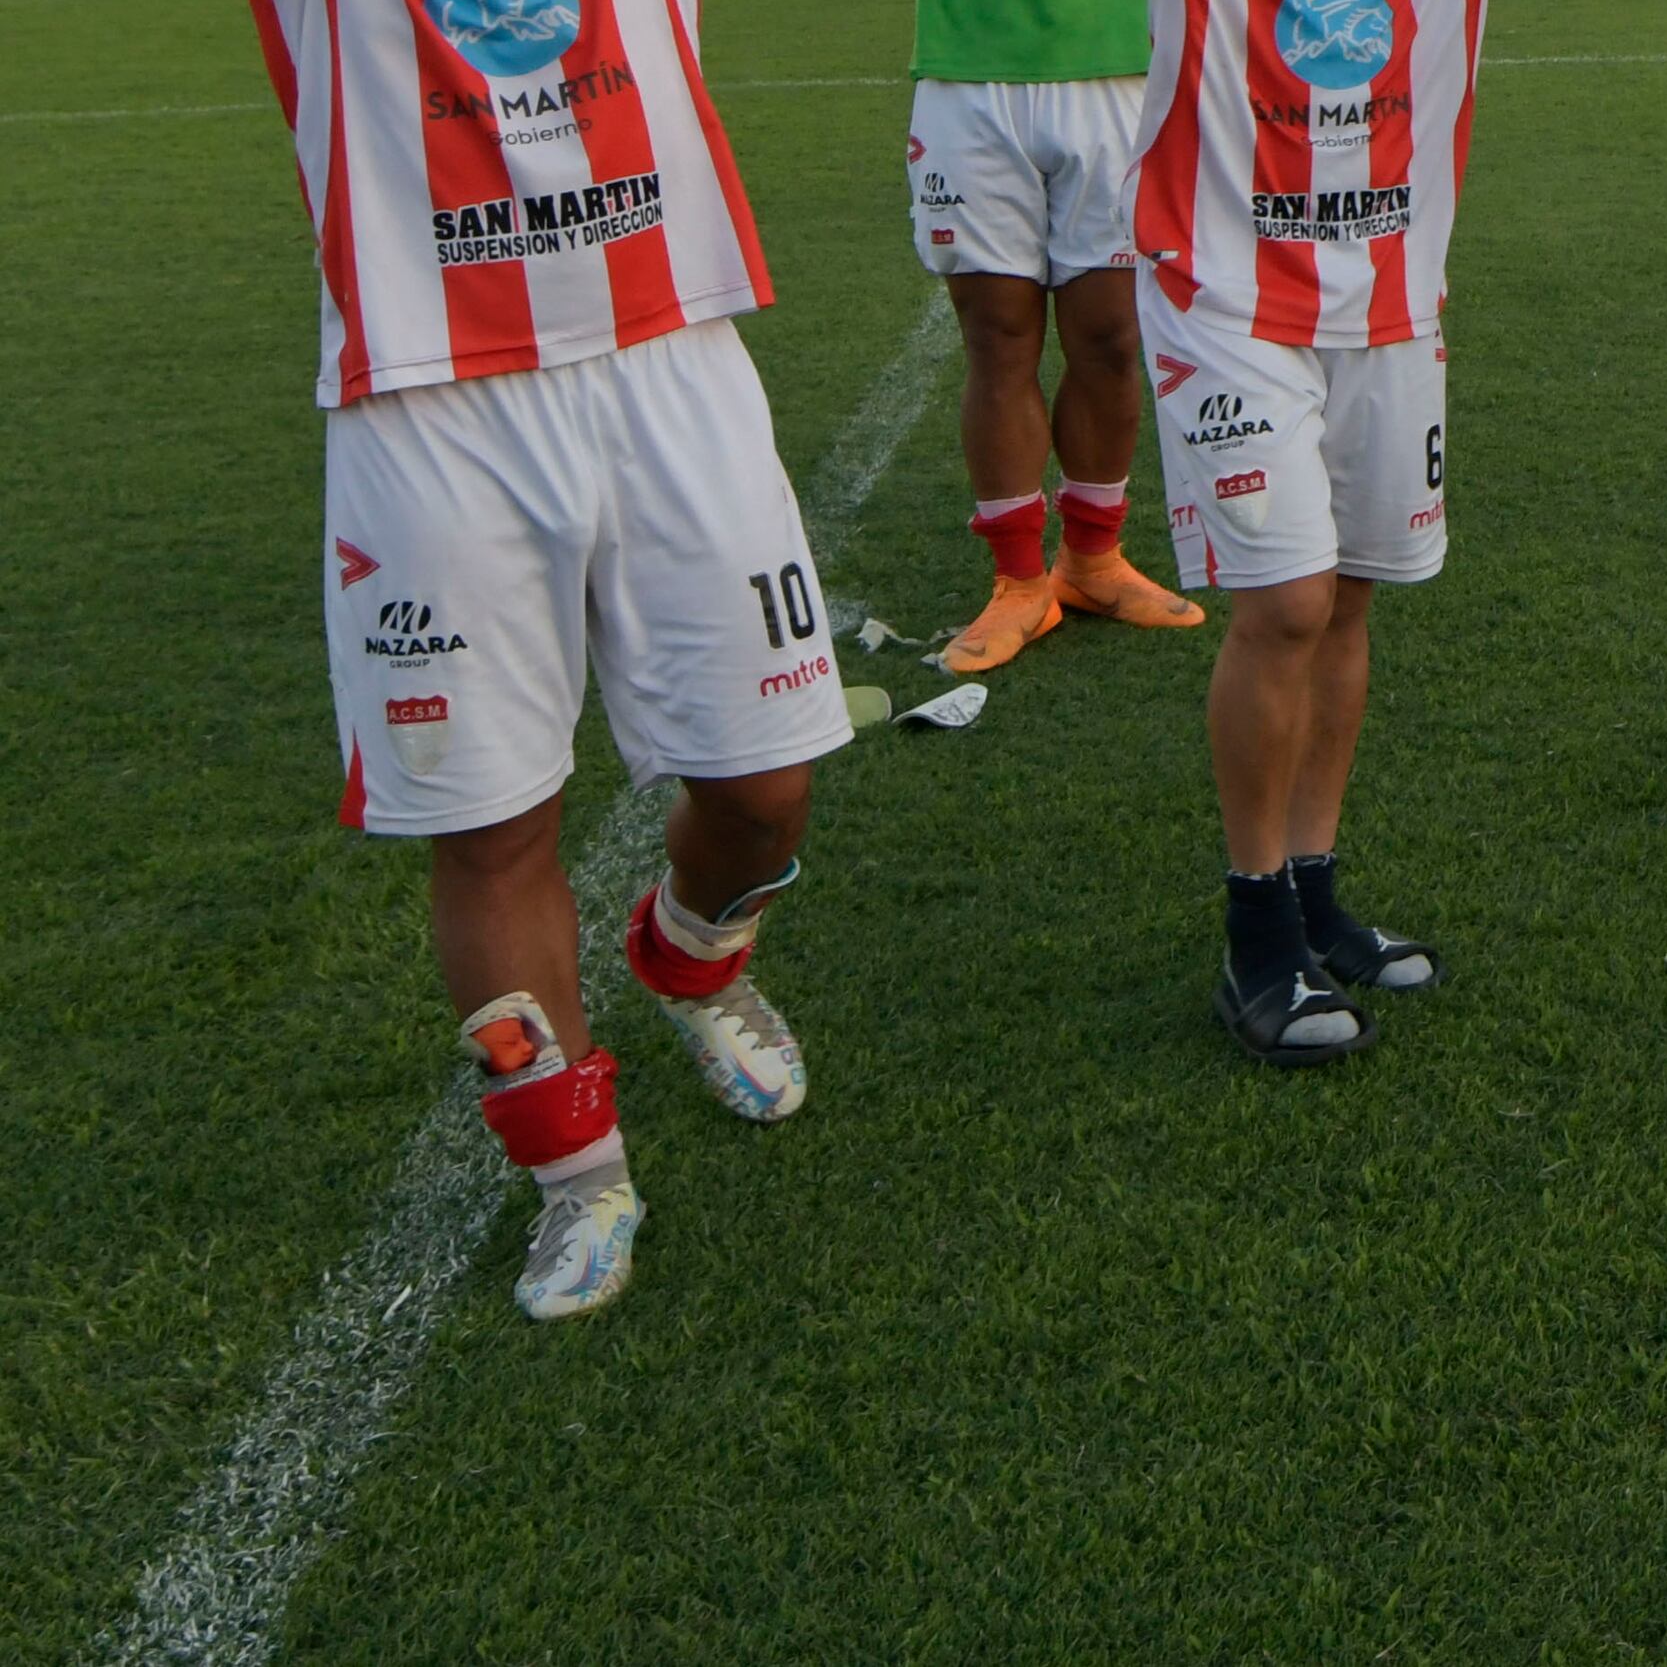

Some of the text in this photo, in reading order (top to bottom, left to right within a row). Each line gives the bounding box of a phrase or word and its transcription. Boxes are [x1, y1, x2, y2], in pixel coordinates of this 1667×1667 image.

[428, 59, 637, 122] SAN MARTÍN
[432, 172, 661, 241] SAN MARTIN
[437, 201, 663, 265] SUSPENSION Y DIRECCION
[1344, 224, 1352, 241] Y
[1183, 419, 1274, 446] MAZARA
[1427, 424, 1442, 490] 6
[749, 560, 816, 650] 10
[365, 632, 469, 656] MAZARA
[759, 654, 831, 699] mitre
